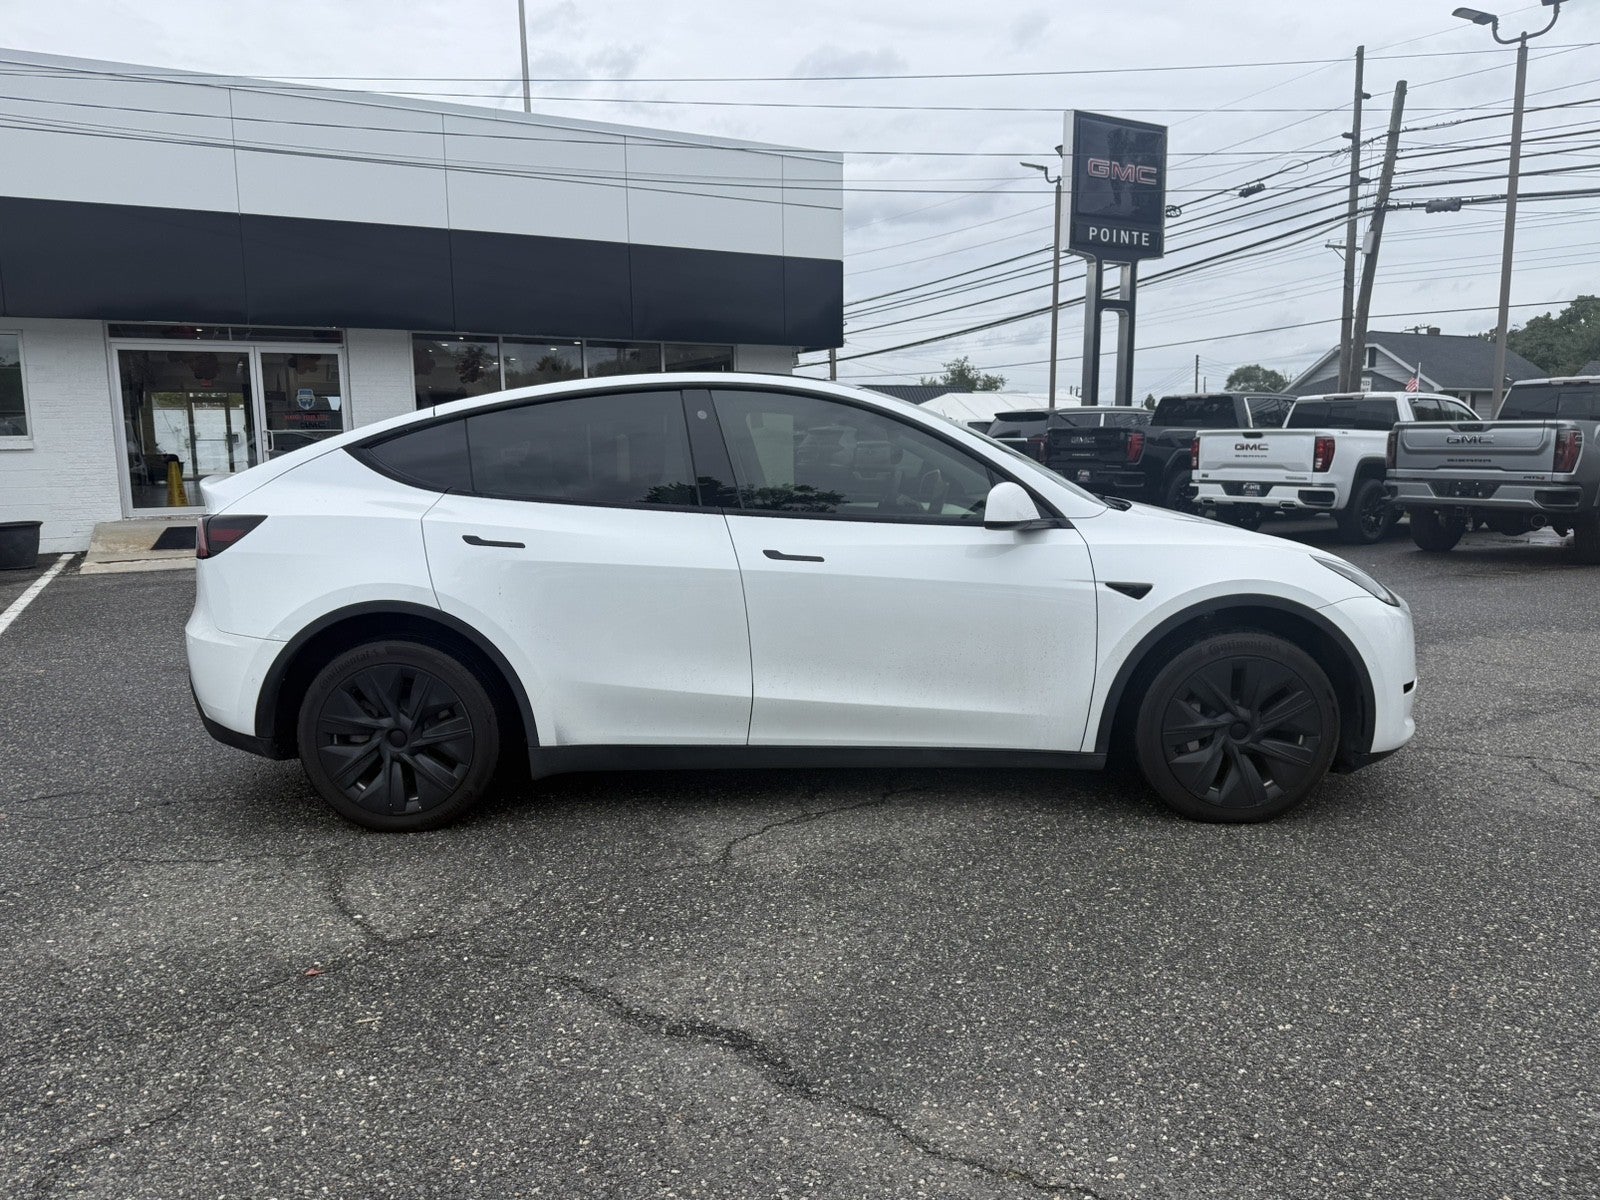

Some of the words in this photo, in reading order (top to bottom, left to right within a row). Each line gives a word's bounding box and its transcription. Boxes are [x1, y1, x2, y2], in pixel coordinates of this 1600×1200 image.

[1088, 158, 1157, 185] GMC
[1089, 227, 1150, 246] POINTE
[1447, 434, 1495, 444] GMC
[1234, 443, 1269, 451] GMC
